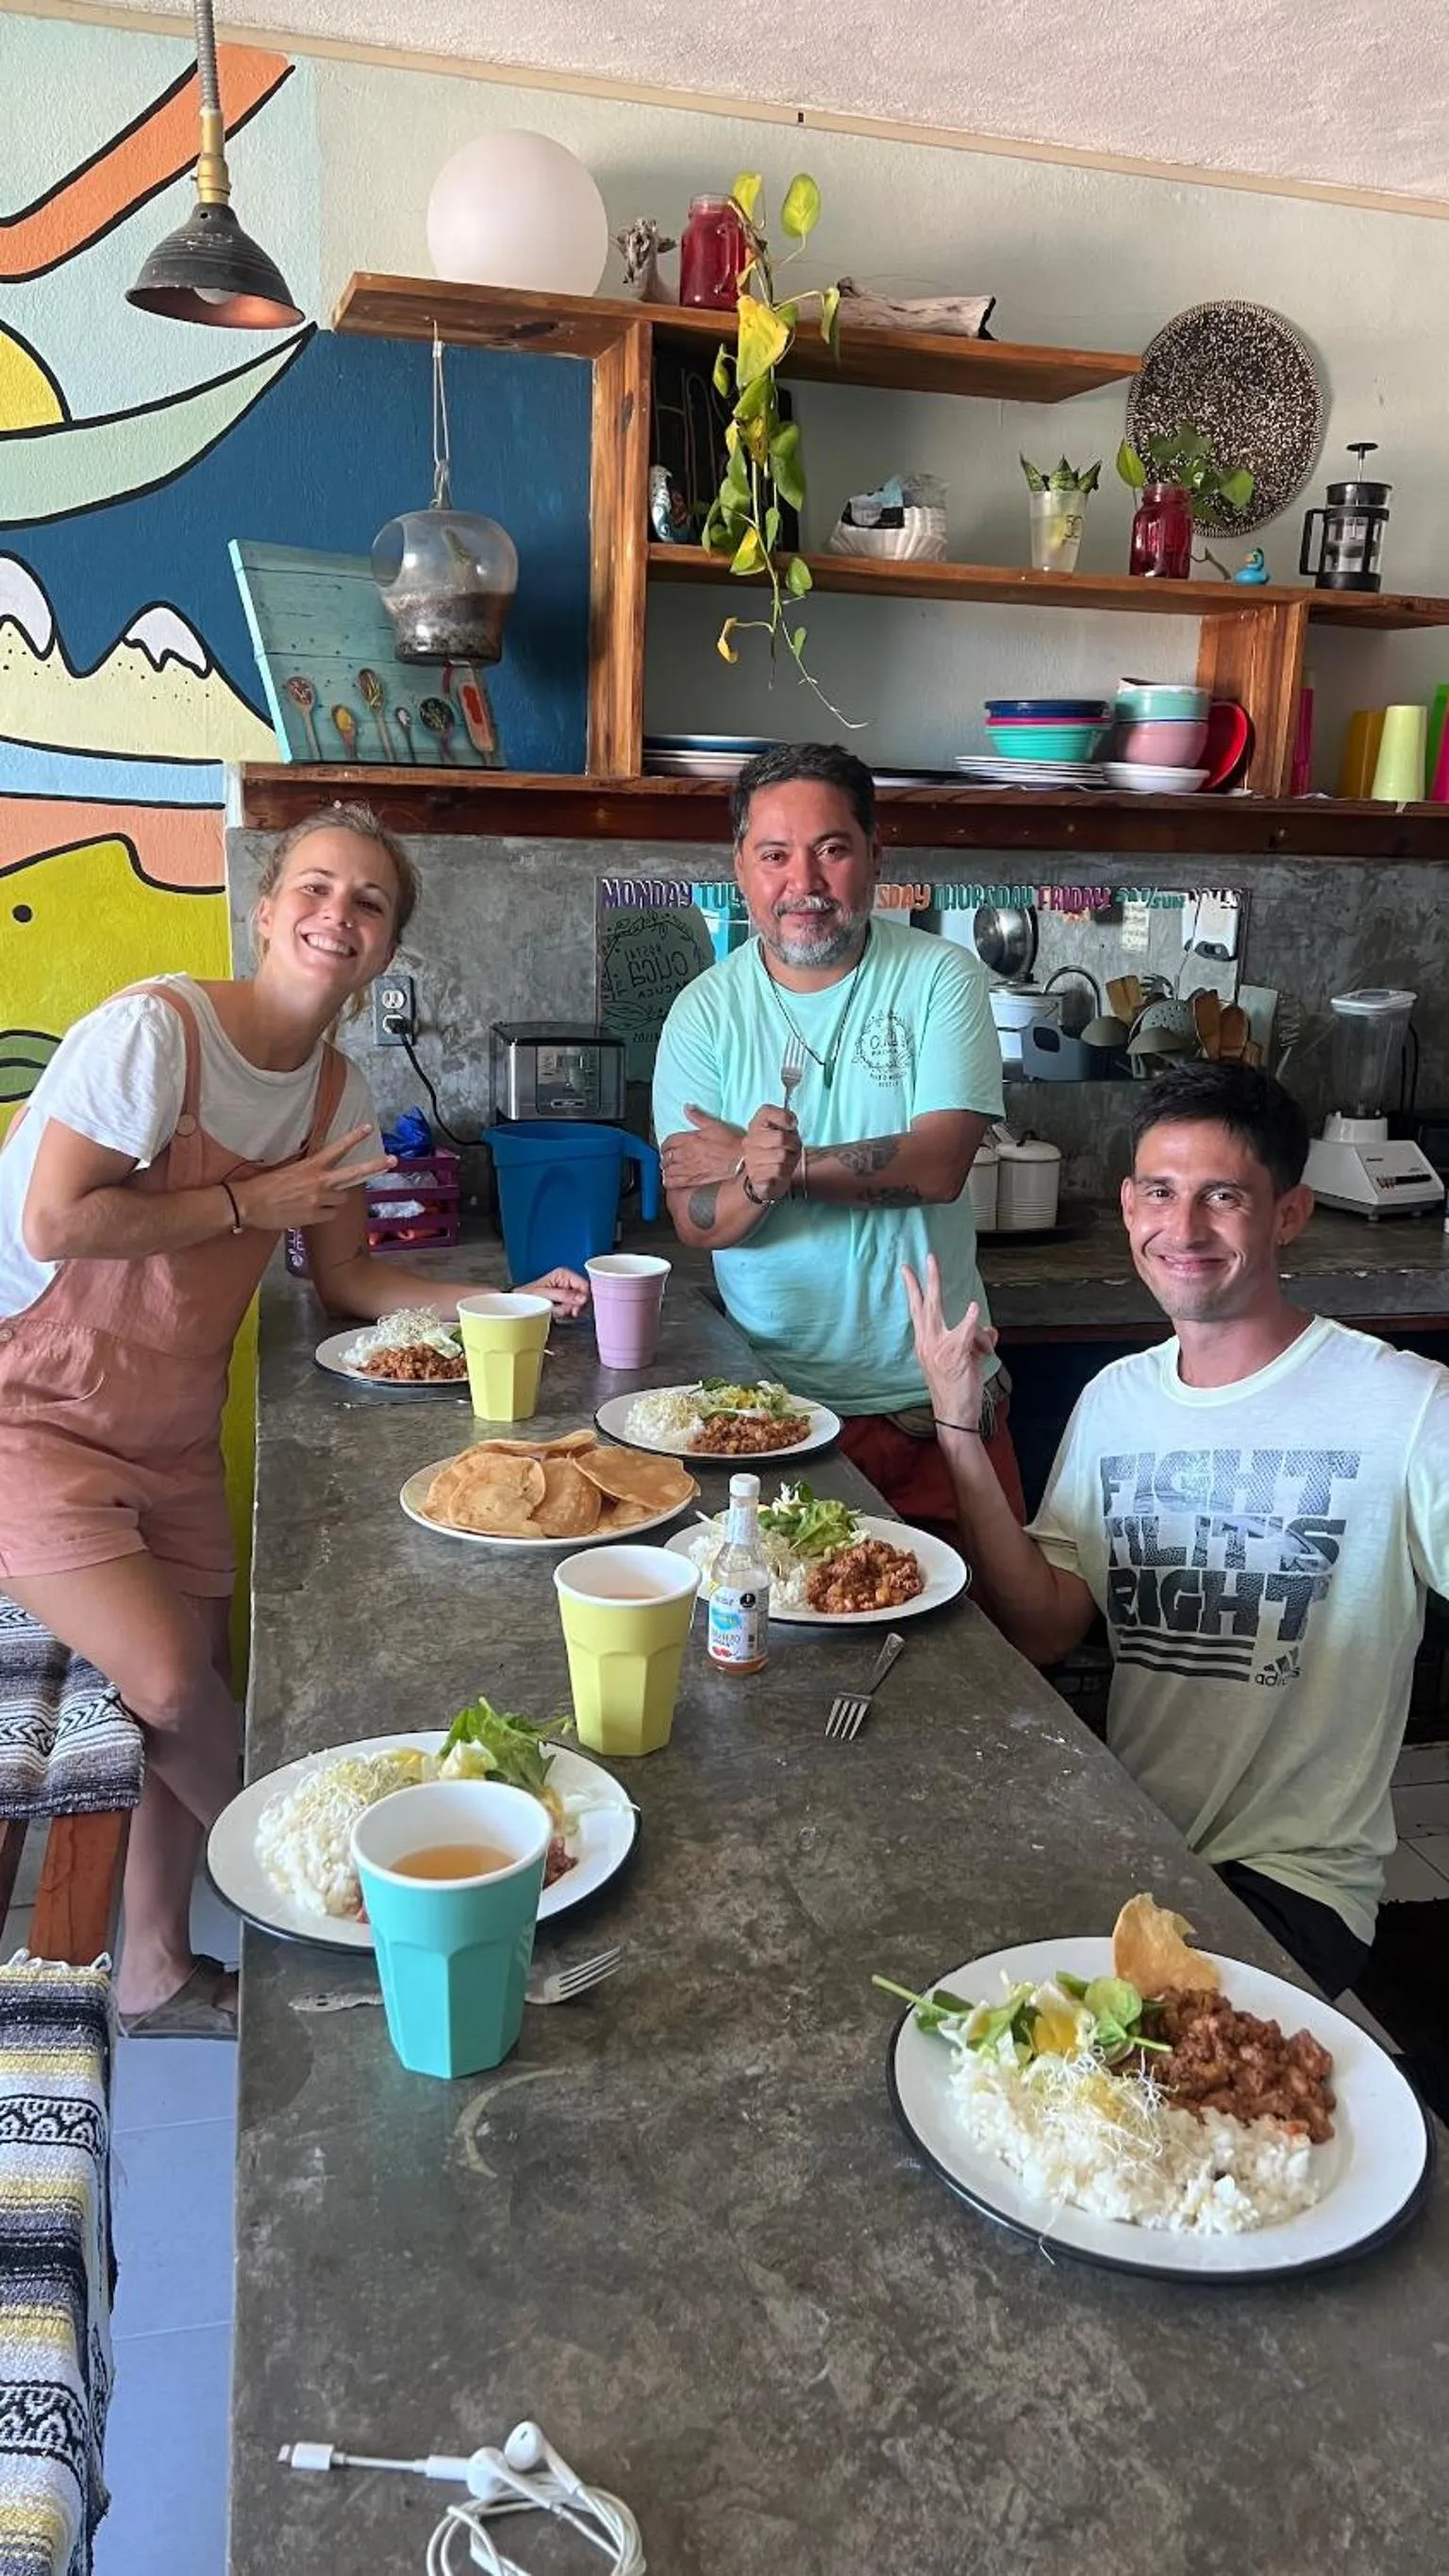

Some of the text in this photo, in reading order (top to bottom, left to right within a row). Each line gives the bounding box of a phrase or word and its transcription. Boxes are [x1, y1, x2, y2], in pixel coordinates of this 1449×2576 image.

[601, 878, 692, 909] MONDAY
[934, 884, 1036, 911] THURSDAY
[1100, 1448, 1361, 1516] FIGHT
[1108, 1568, 1335, 1642] RIGHT
